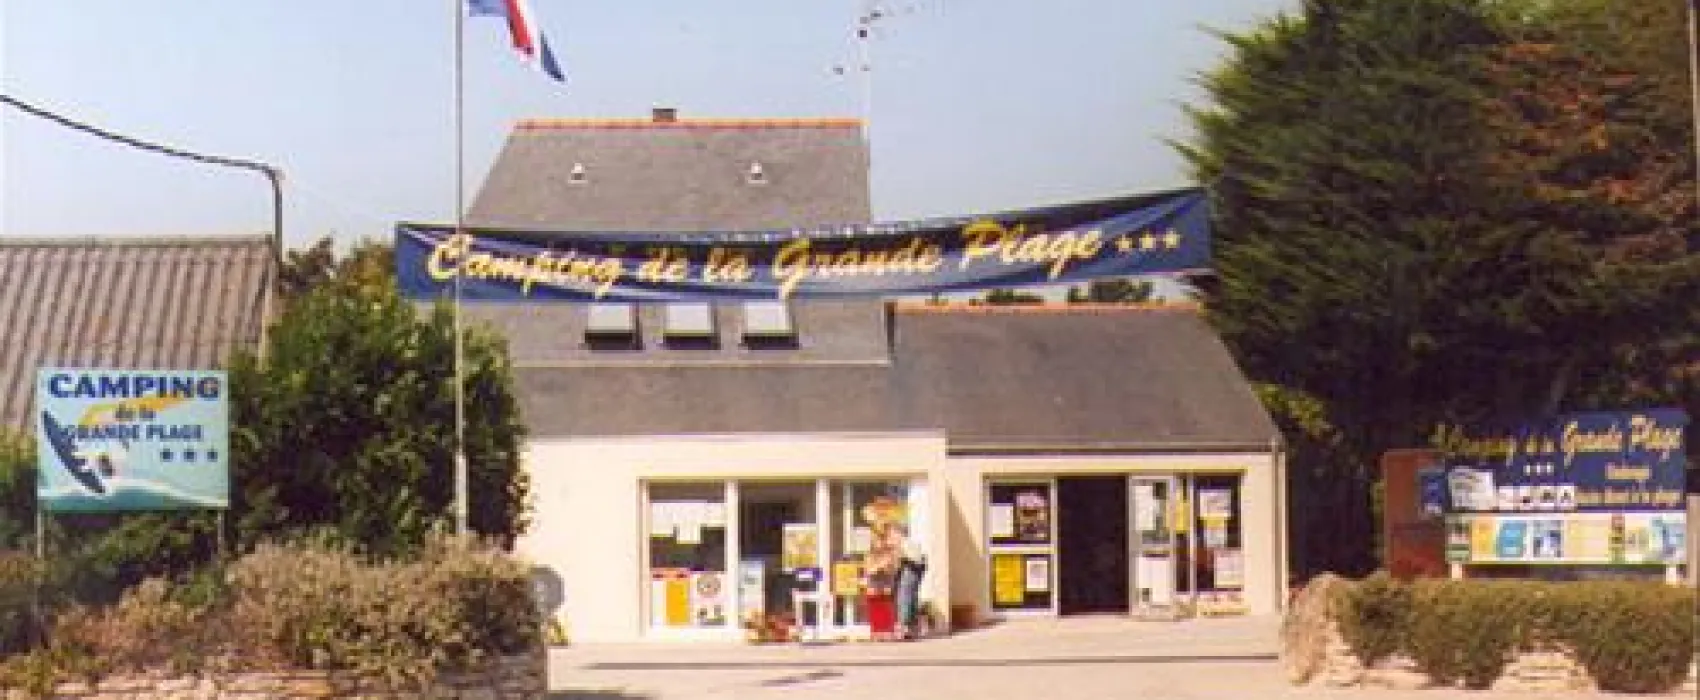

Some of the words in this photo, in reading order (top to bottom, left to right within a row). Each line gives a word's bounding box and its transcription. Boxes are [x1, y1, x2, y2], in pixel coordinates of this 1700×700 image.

[428, 233, 622, 300] Camping
[637, 247, 689, 284] de
[703, 246, 750, 284] la
[772, 238, 942, 302] Grande
[959, 219, 1102, 280] Plage
[48, 373, 220, 400] CAMPING
[114, 402, 135, 421] de
[139, 403, 155, 421] la
[64, 425, 140, 441] GRANDE
[146, 425, 203, 441] PLAGE
[1560, 420, 1623, 468] Grande
[1630, 415, 1682, 462] Plage
